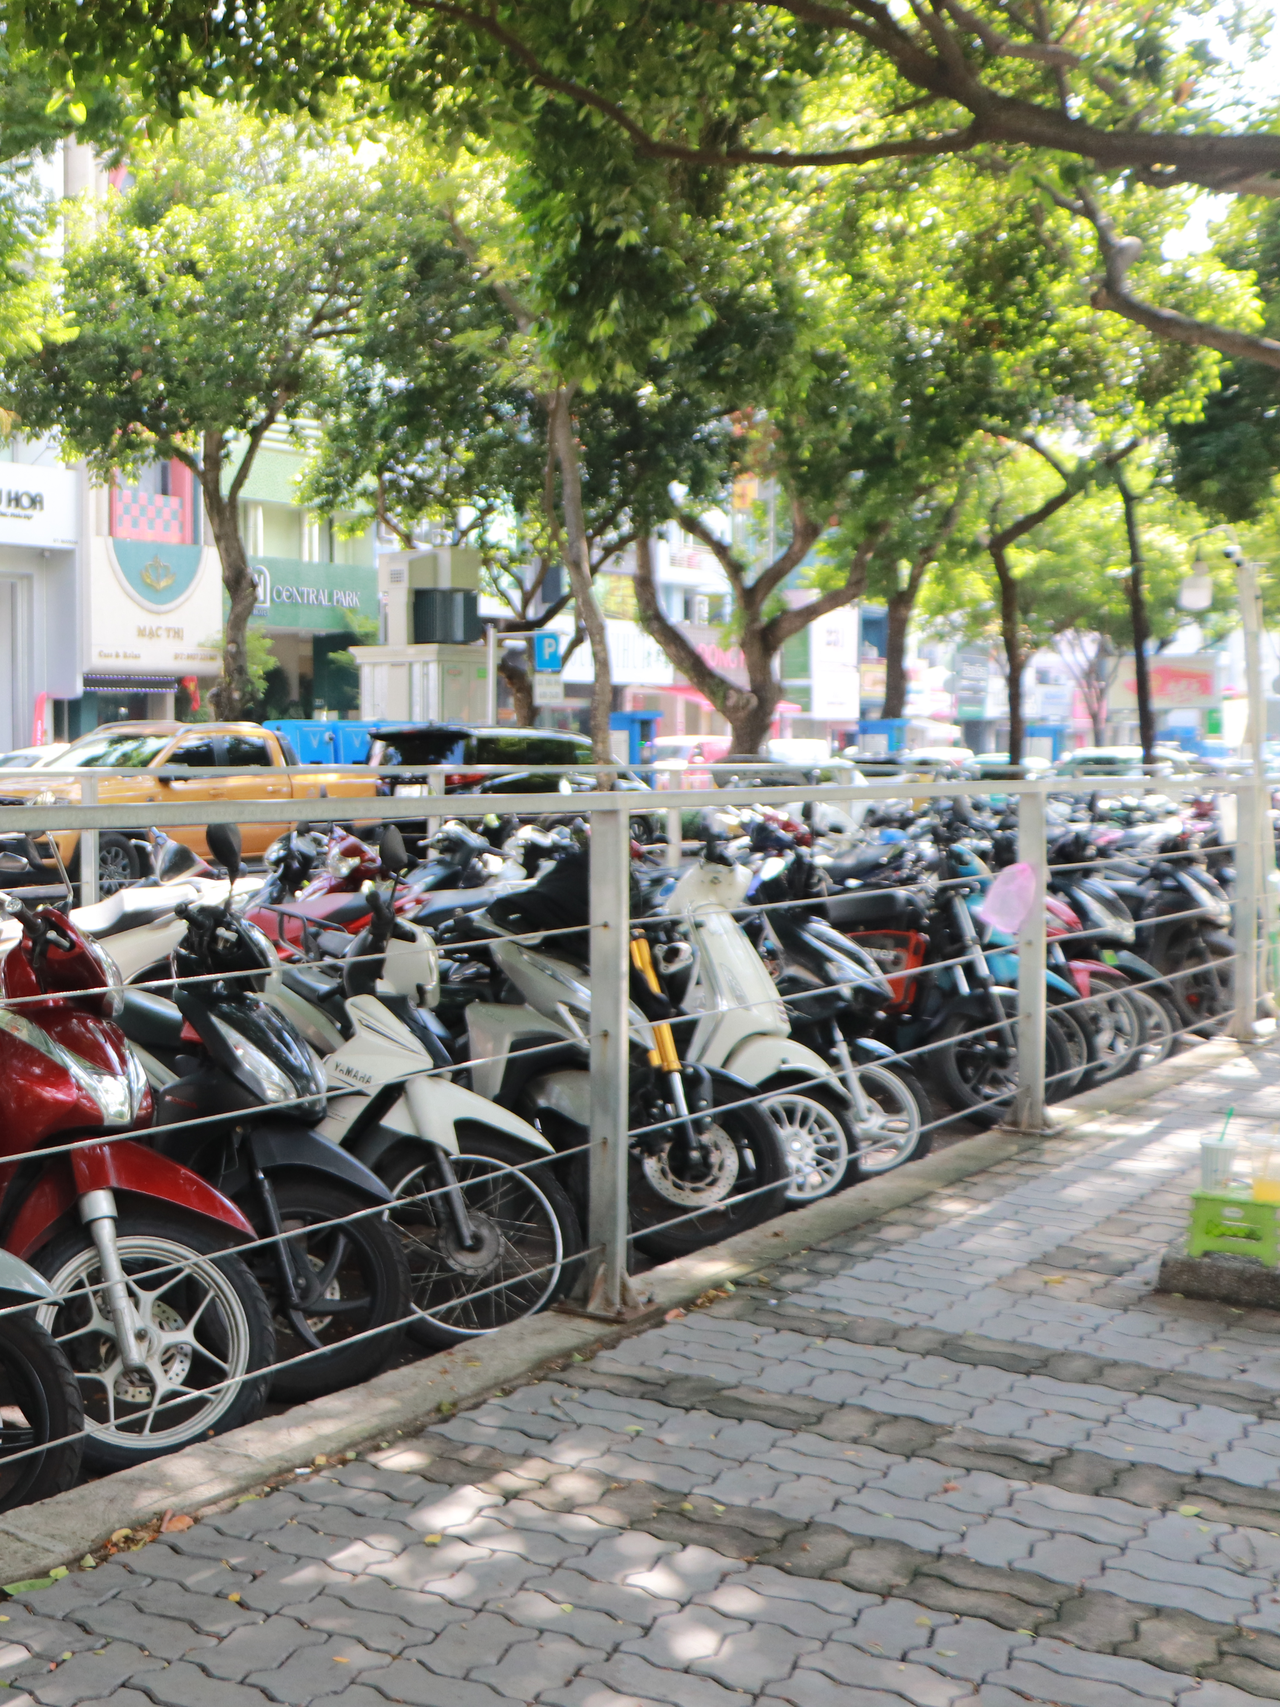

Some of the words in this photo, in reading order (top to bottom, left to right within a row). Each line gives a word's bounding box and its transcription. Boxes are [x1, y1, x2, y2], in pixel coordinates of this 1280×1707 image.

[6, 490, 45, 512] HOA
[272, 585, 331, 607] CENTRAL
[333, 590, 361, 607] PARK
[544, 638, 556, 660] P
[334, 1061, 373, 1085] YAMAHA
